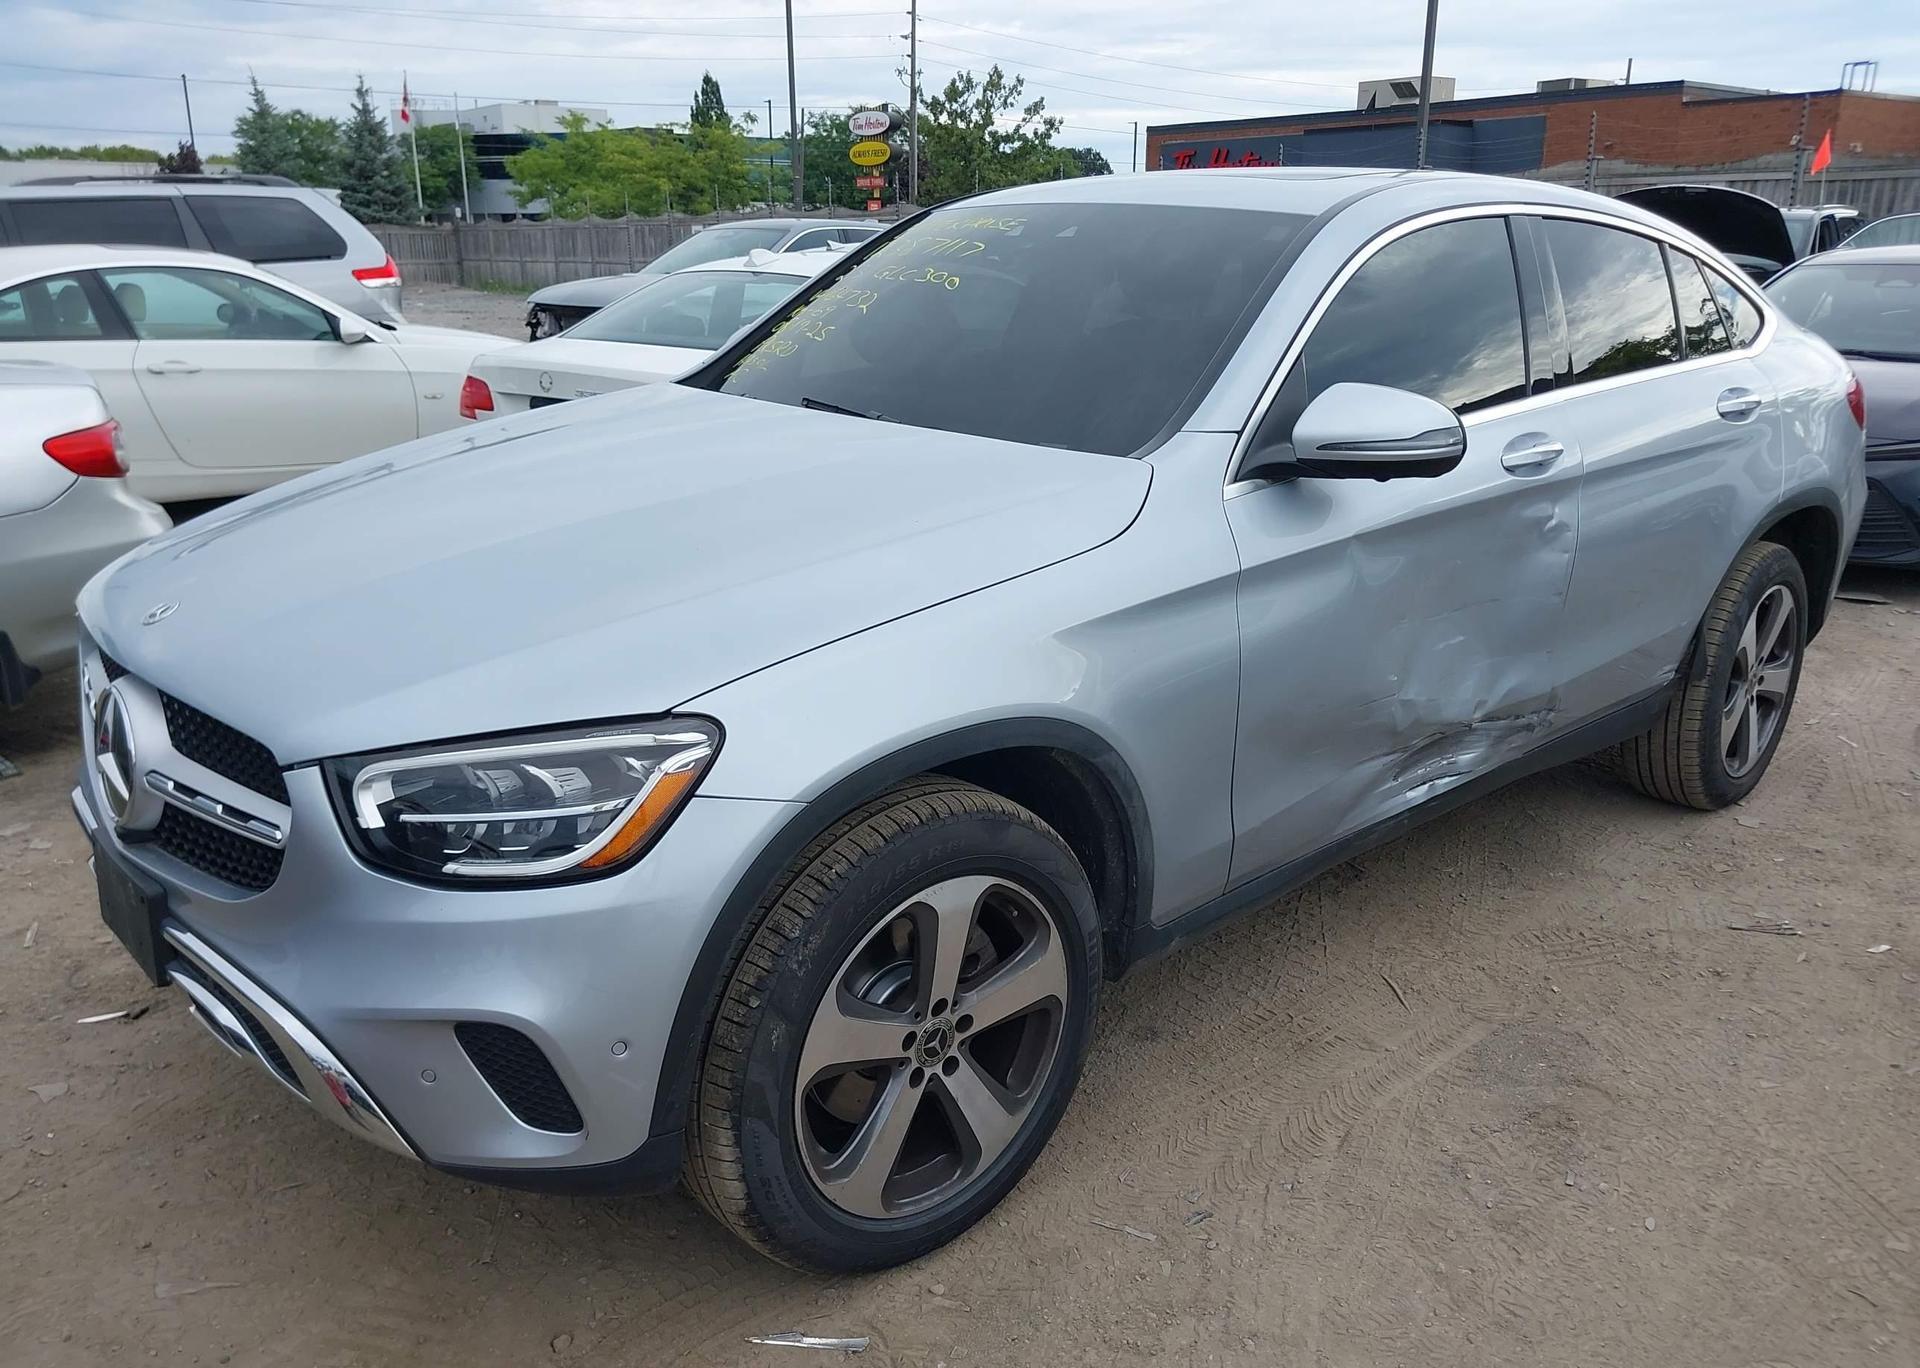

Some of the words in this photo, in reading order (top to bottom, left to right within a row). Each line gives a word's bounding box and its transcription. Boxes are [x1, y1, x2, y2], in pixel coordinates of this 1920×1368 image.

[852, 117, 864, 131] Tim
[864, 116, 887, 130] Hortons
[871, 148, 888, 157] FRESH
[873, 265, 918, 281] GLC
[914, 267, 960, 290] 300
